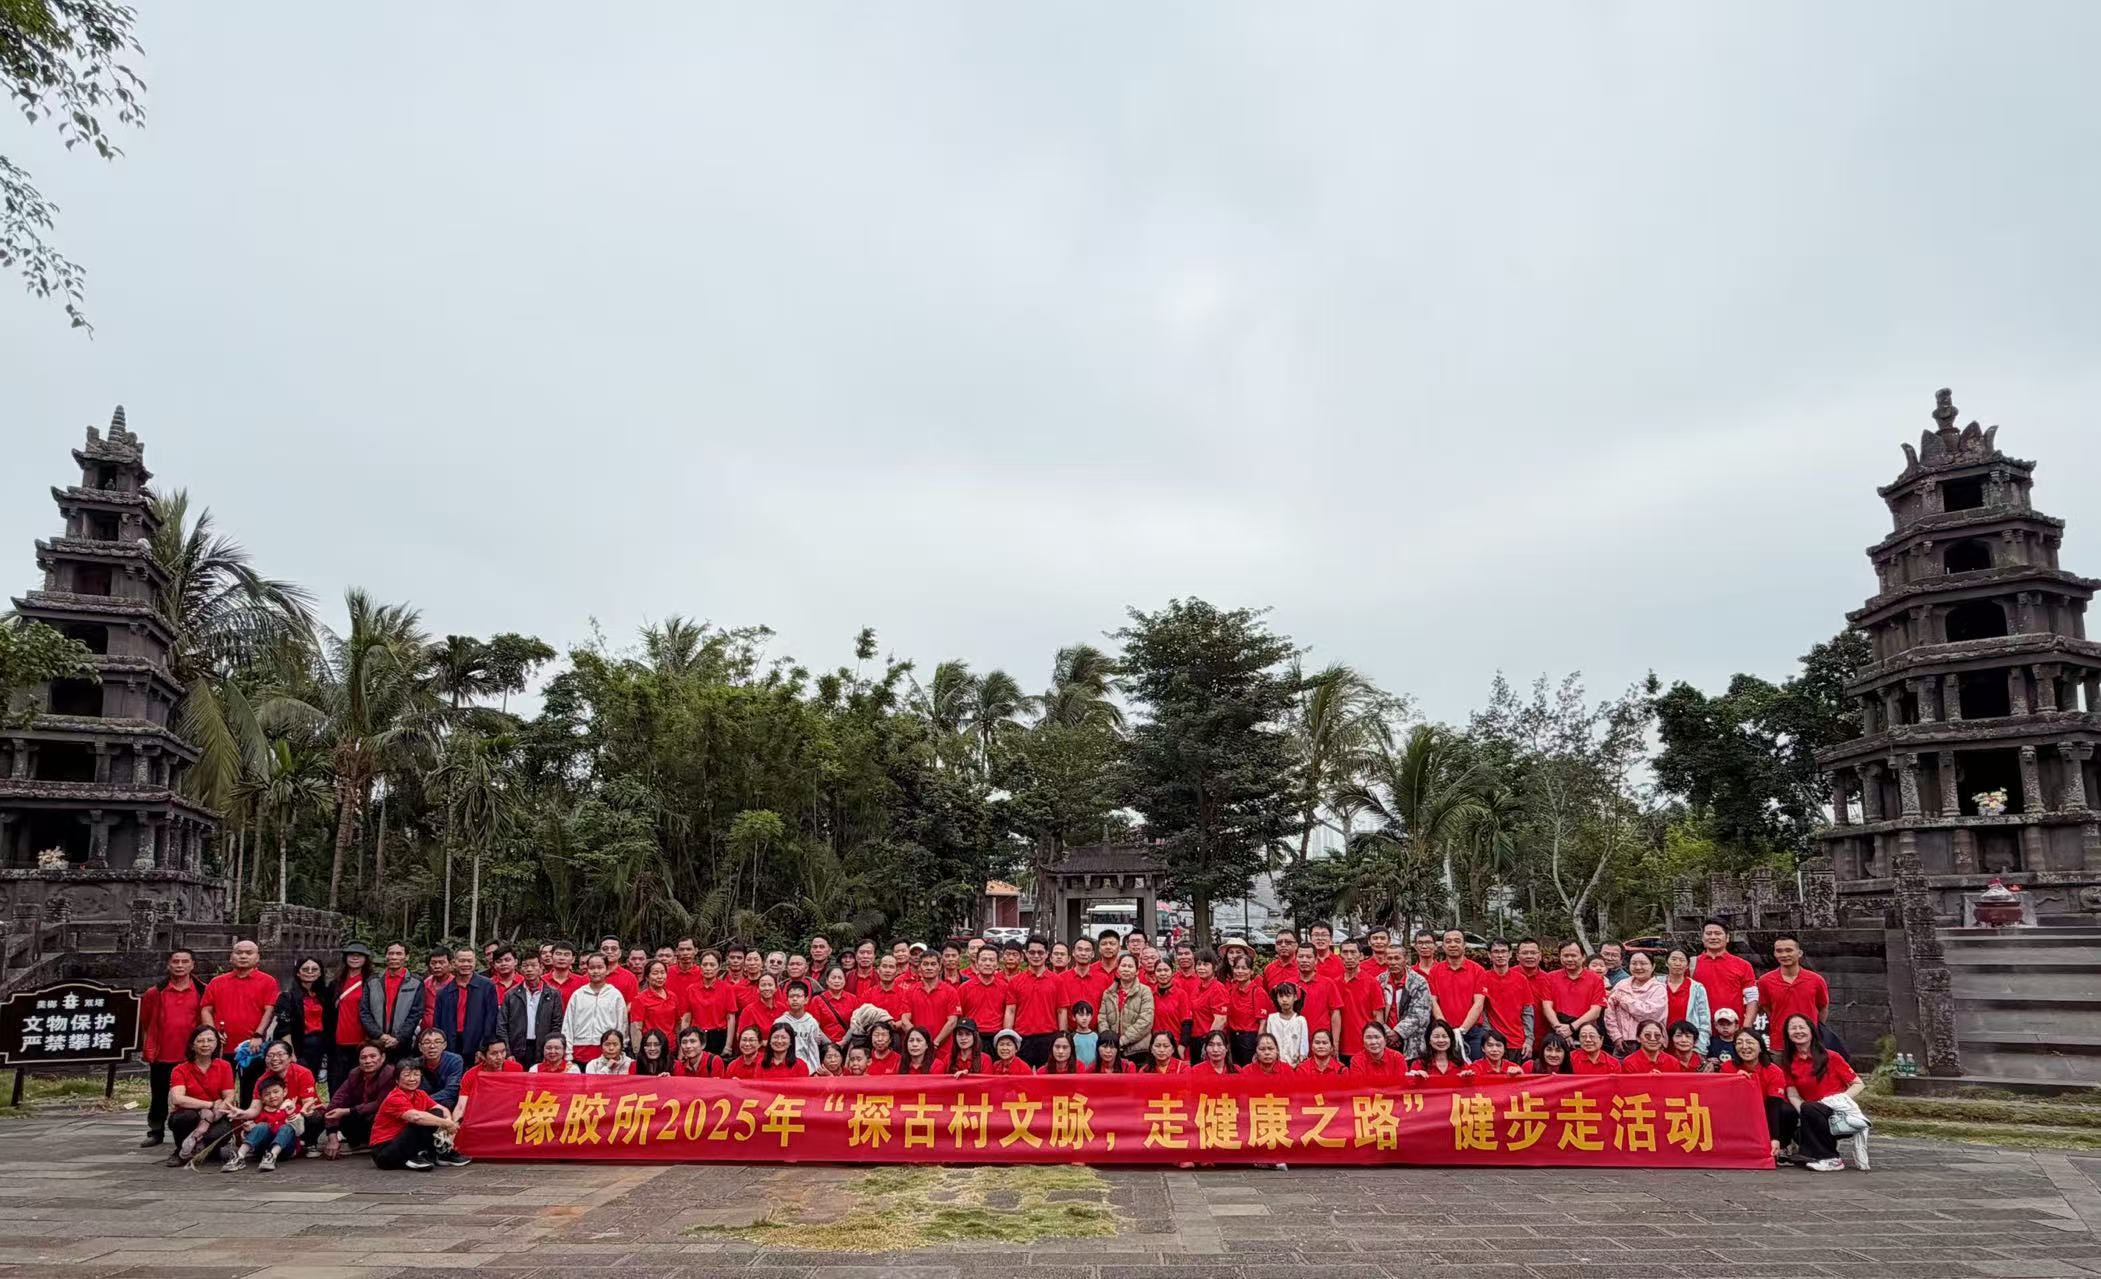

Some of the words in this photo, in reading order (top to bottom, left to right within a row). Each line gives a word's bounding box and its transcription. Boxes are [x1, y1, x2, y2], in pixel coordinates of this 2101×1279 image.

[21, 1013, 116, 1032] 文物保护
[19, 1033, 114, 1053] 严禁攀塔
